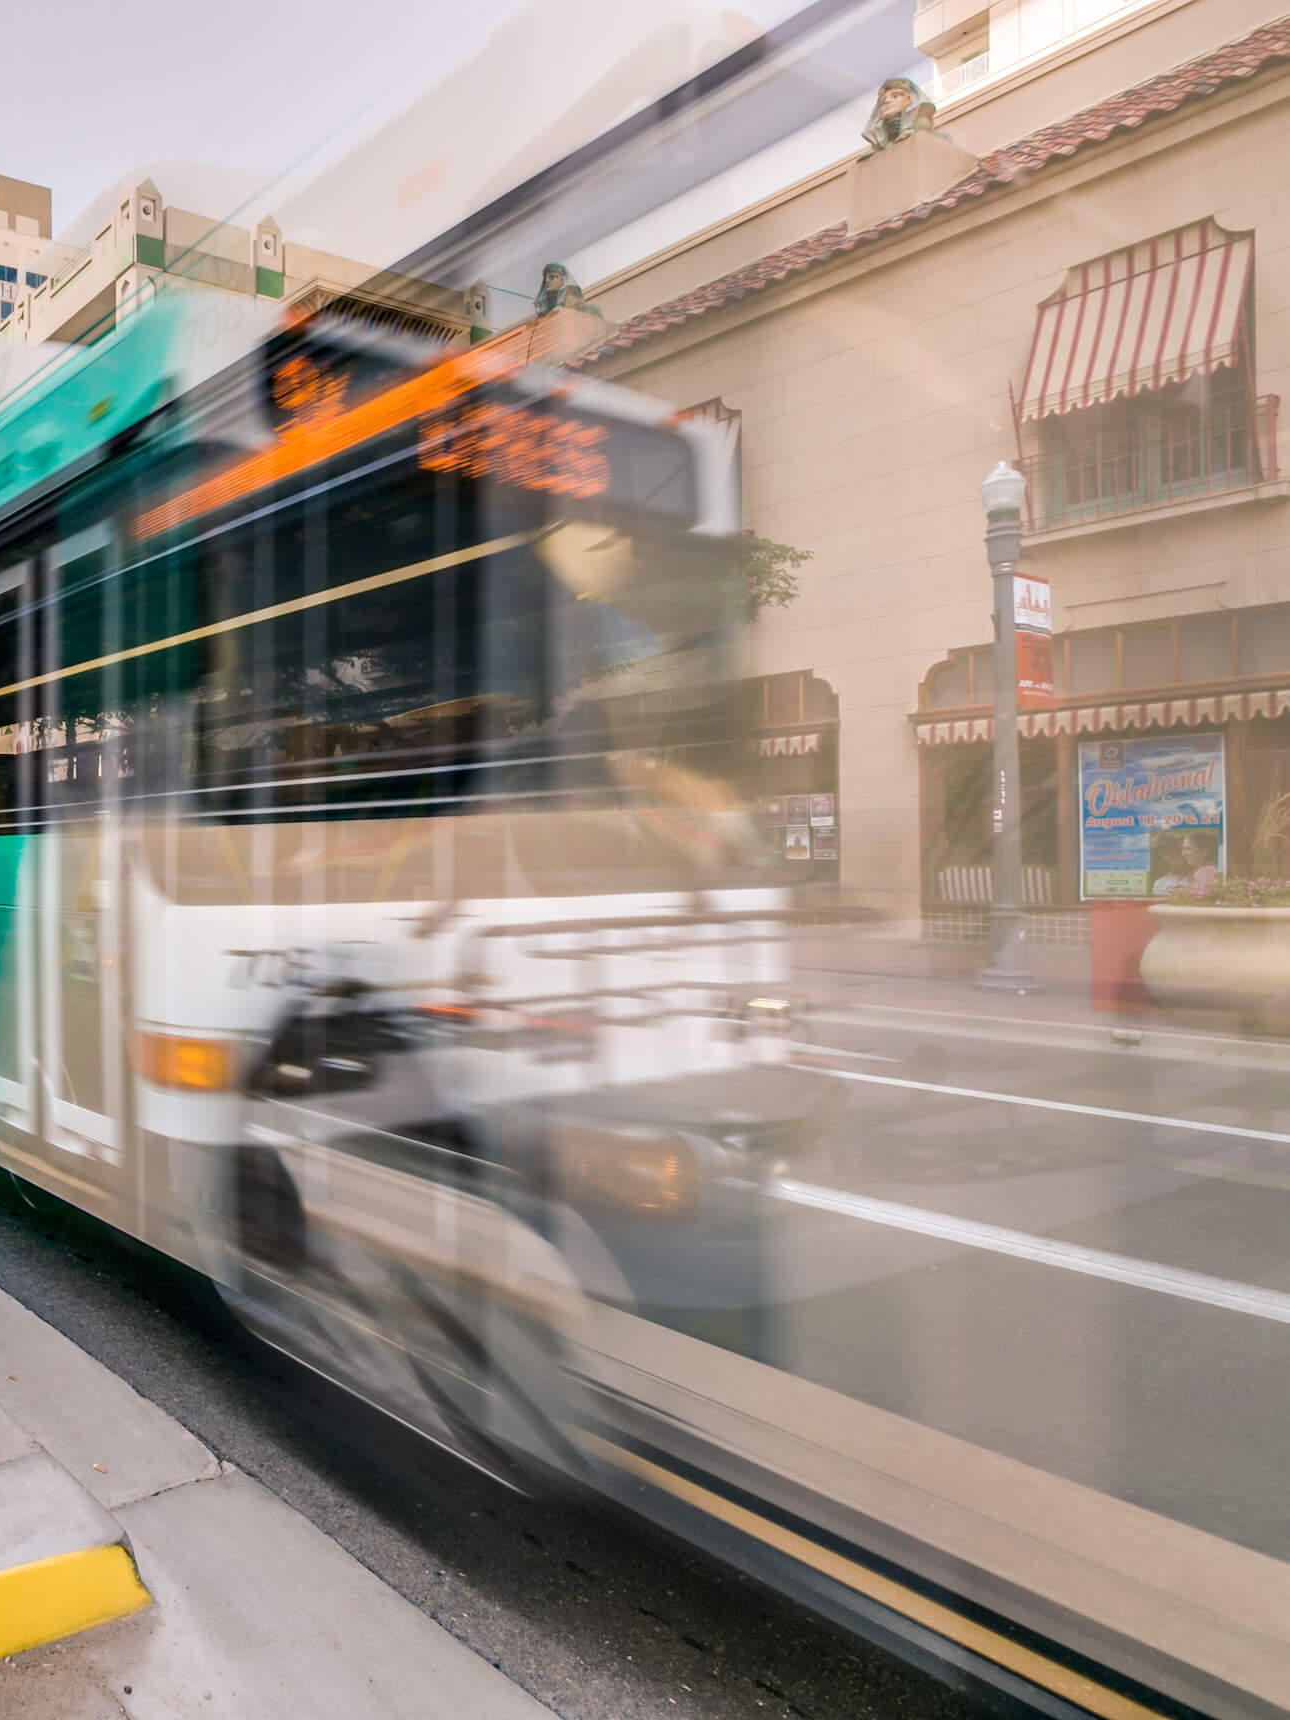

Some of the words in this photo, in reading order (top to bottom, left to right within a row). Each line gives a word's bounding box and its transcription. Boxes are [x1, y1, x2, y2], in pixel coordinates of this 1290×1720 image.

[1085, 759, 1215, 817] Oklahoma!
[1085, 816, 1135, 829] August
[1164, 815, 1183, 825] 20
[1185, 814, 1198, 825] &
[1202, 813, 1220, 825] 21
